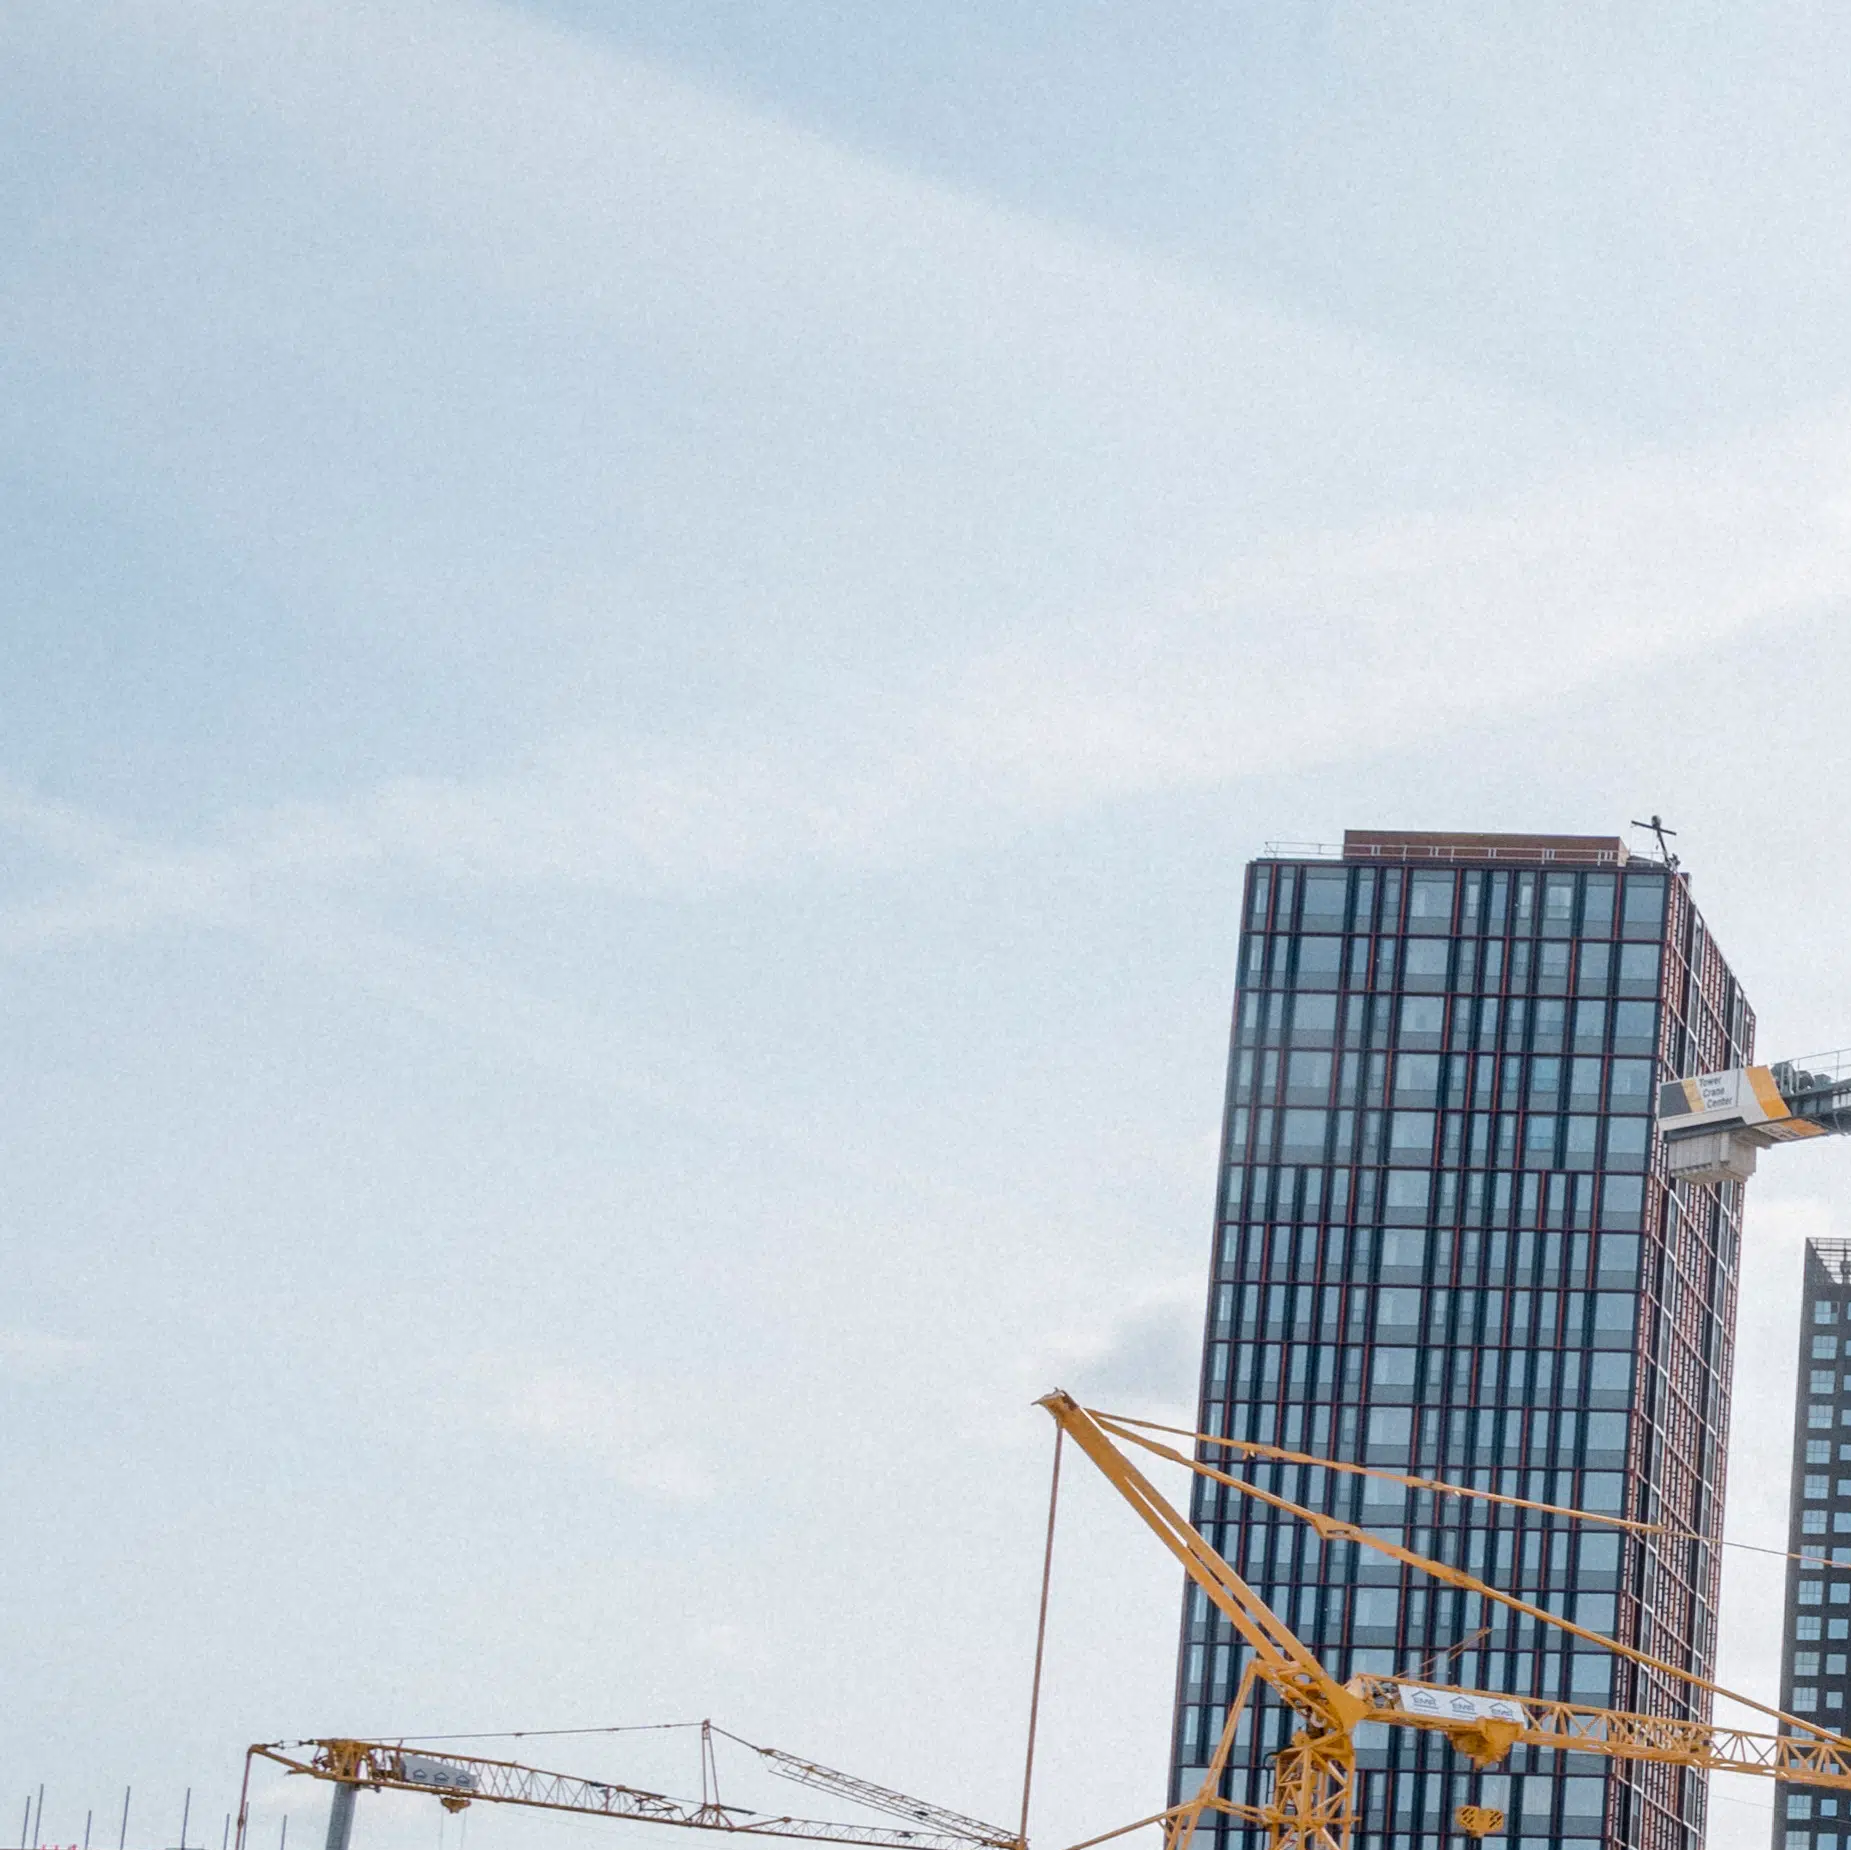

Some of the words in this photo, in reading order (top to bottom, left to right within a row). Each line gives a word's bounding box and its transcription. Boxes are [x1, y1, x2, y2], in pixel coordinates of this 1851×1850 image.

[1700, 1075, 1722, 1087] Tower
[1703, 1086, 1725, 1098] Crane
[1707, 1096, 1732, 1109] Center
